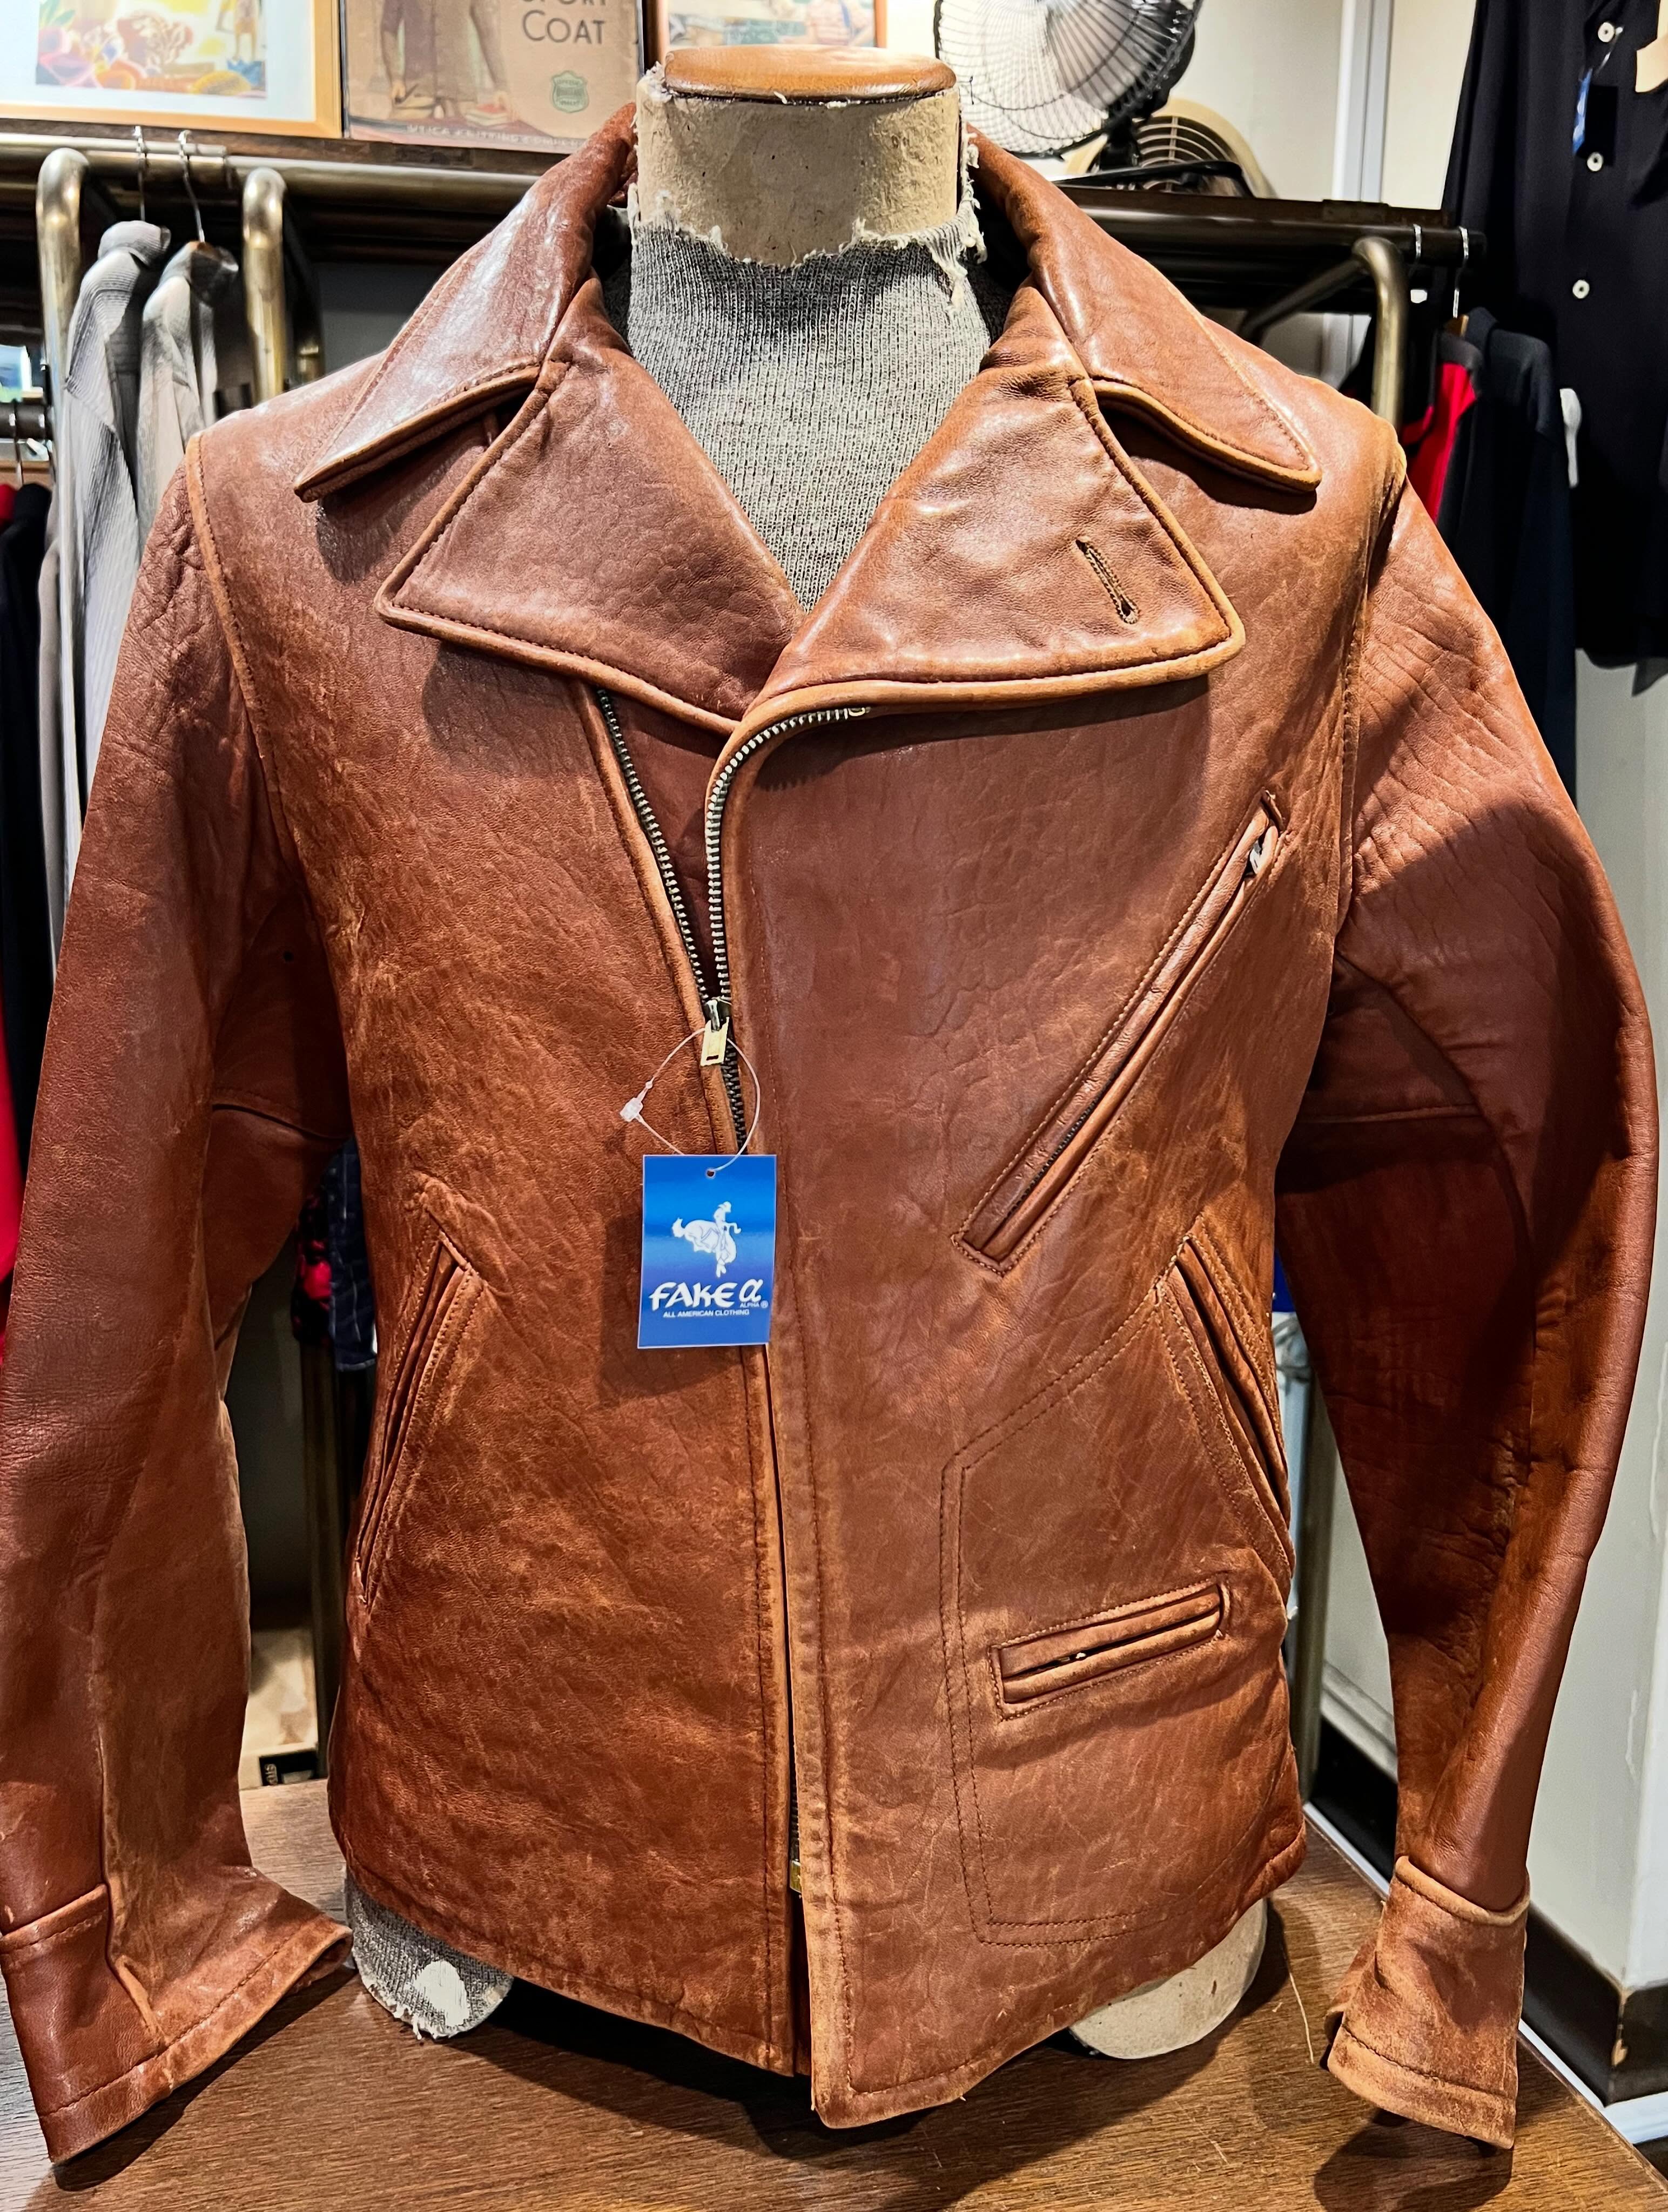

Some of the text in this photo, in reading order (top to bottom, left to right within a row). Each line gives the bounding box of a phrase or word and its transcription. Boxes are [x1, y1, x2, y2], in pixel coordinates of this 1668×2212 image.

[522, 9, 606, 44] COAT
[649, 1282, 738, 1311] FAKE
[677, 1310, 714, 1318] AMERICAN
